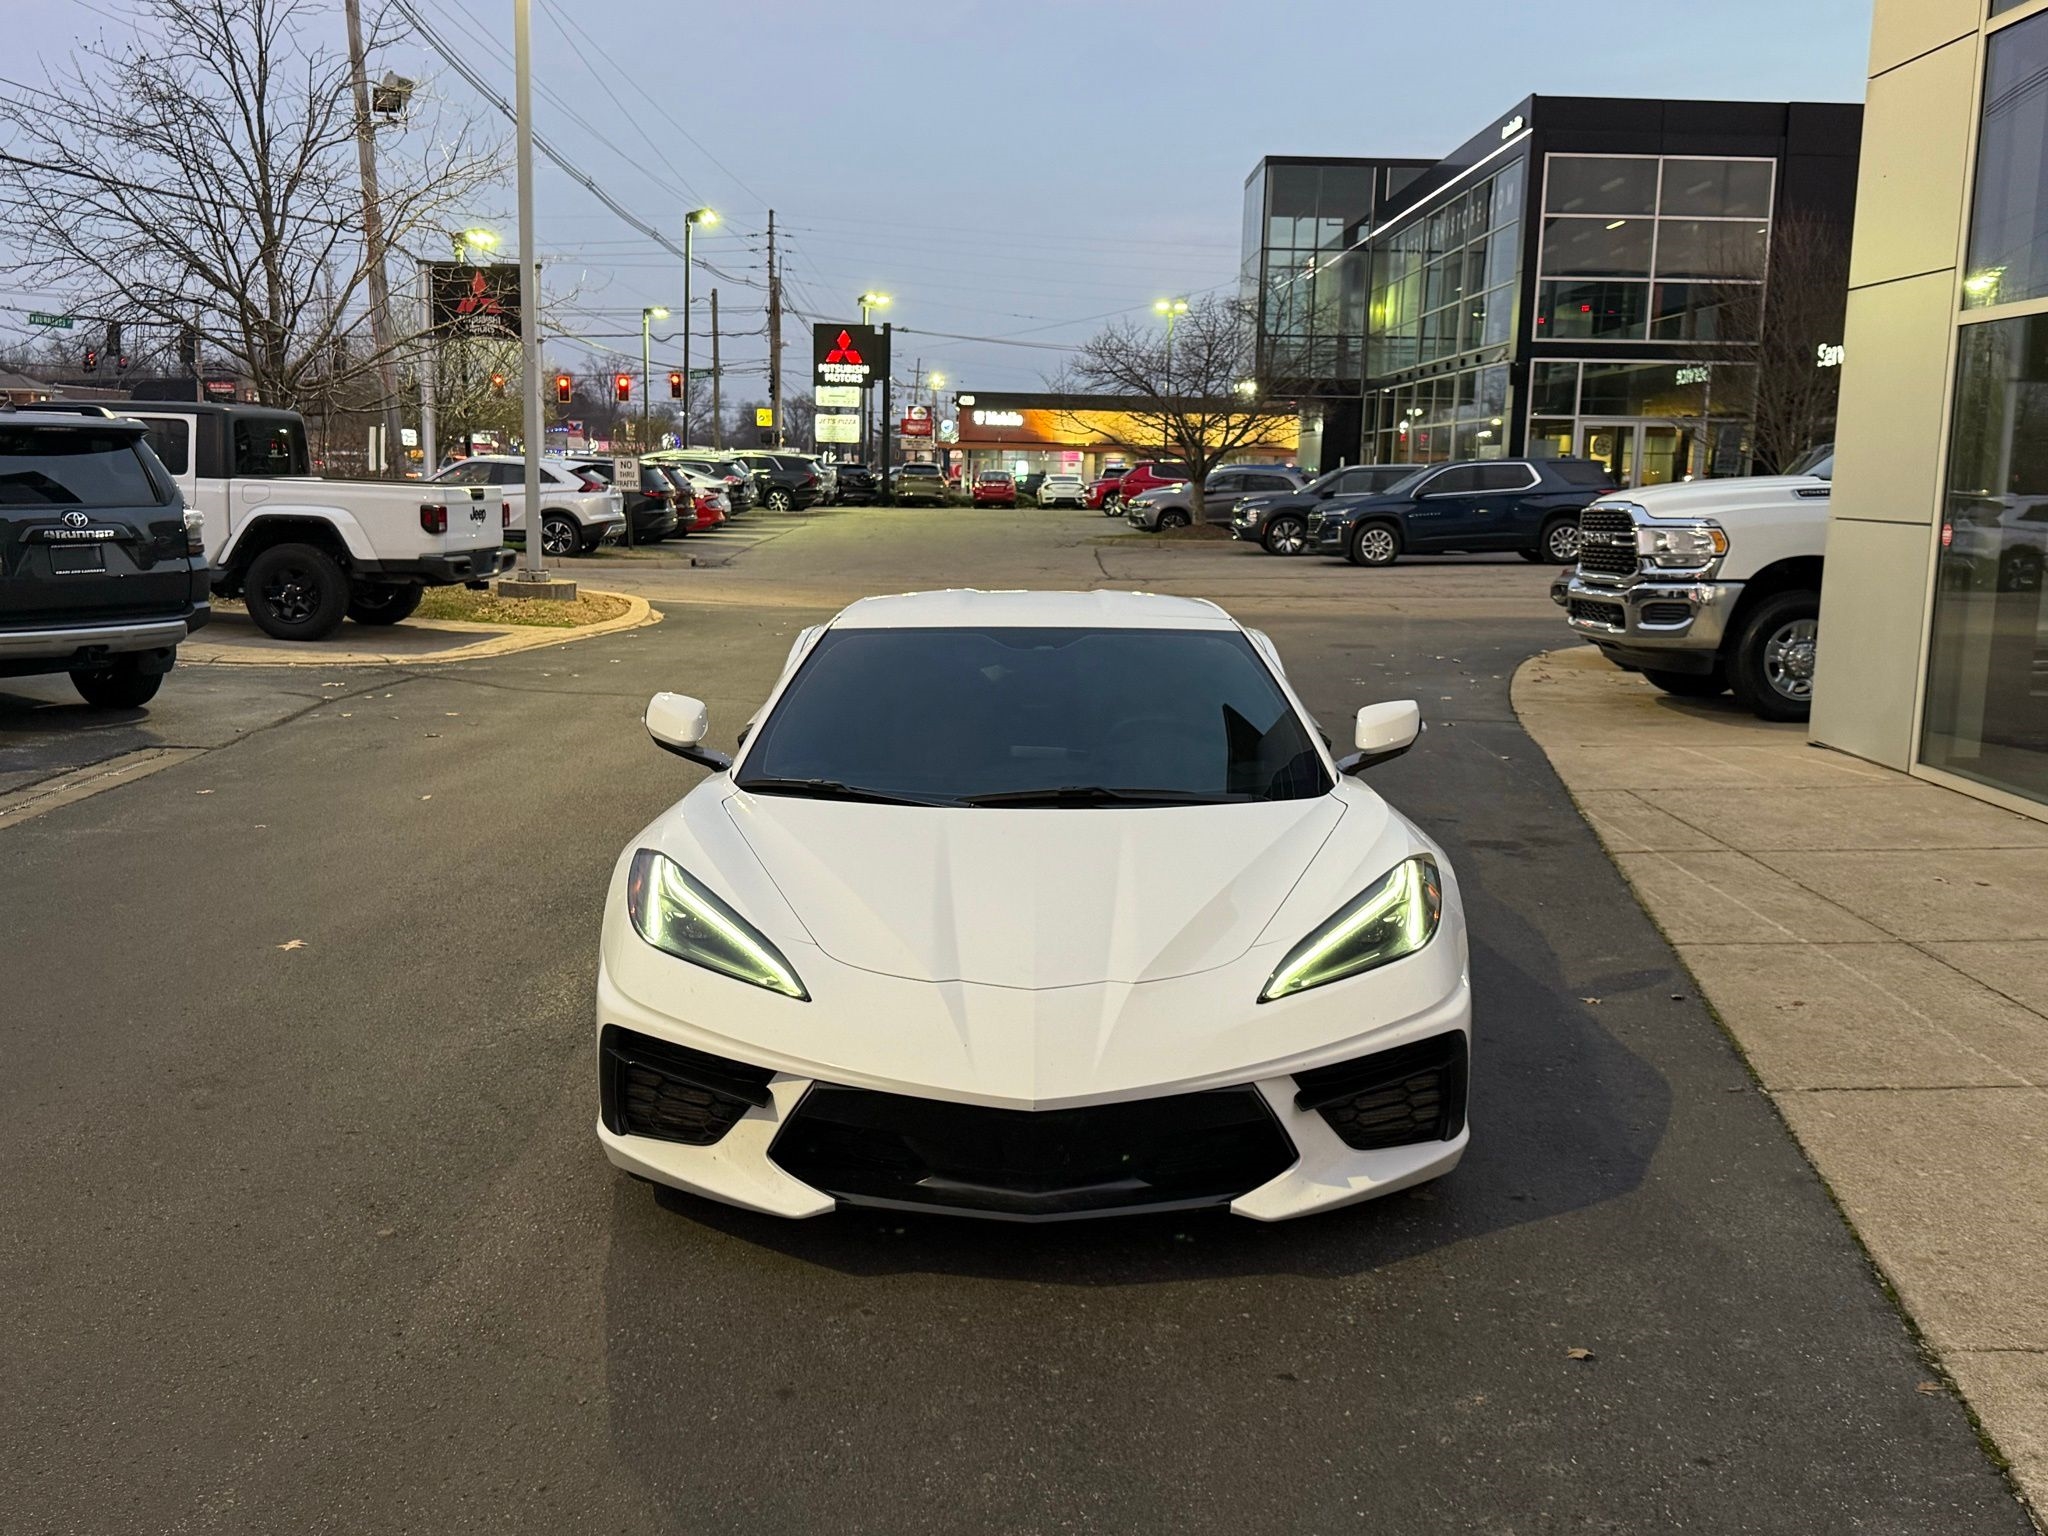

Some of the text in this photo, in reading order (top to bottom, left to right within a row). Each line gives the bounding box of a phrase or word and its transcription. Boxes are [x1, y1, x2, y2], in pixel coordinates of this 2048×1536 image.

[459, 314, 501, 325] MSUBISHI
[620, 460, 632, 469] NO
[617, 480, 639, 488] TRAFFIC
[470, 505, 487, 523] Jeep
